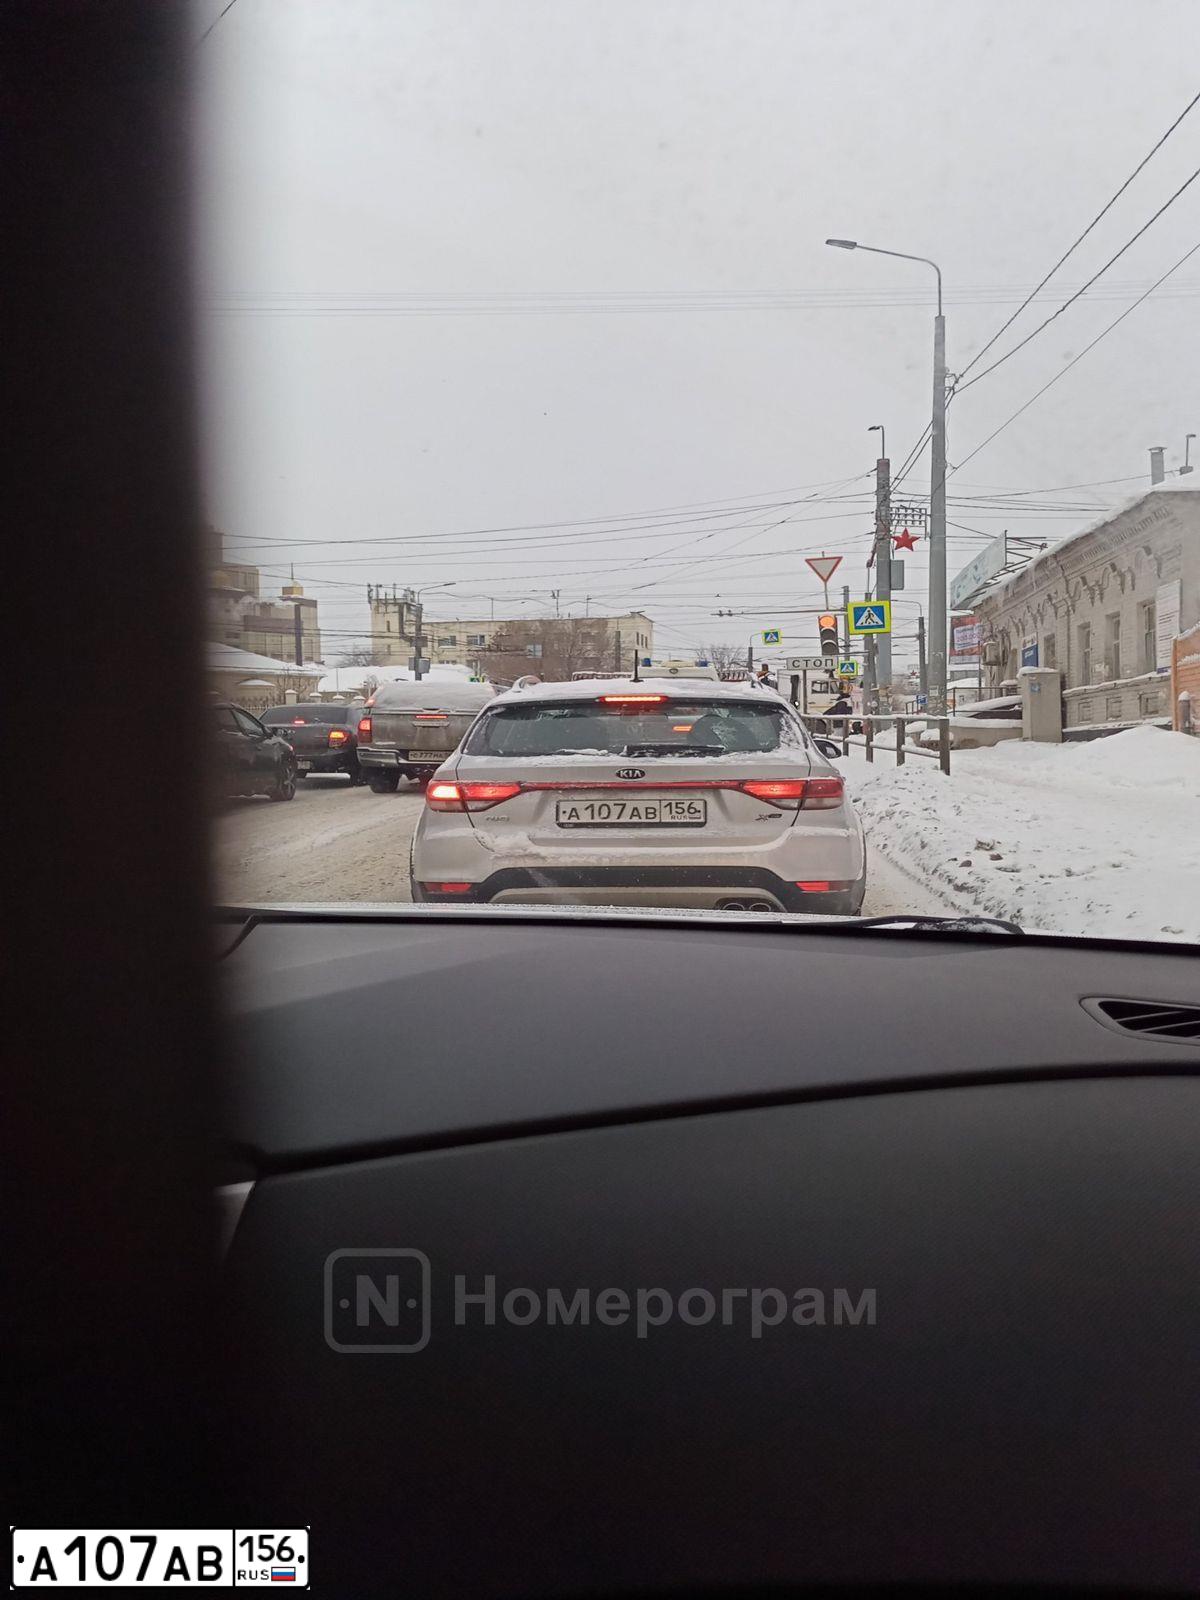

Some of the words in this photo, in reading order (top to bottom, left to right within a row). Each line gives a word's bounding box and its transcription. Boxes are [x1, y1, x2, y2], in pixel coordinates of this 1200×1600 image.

[792, 658, 834, 668] СТОП
[619, 769, 643, 778] KIA
[567, 803, 657, 820] А107АВ
[663, 802, 698, 815] 156
